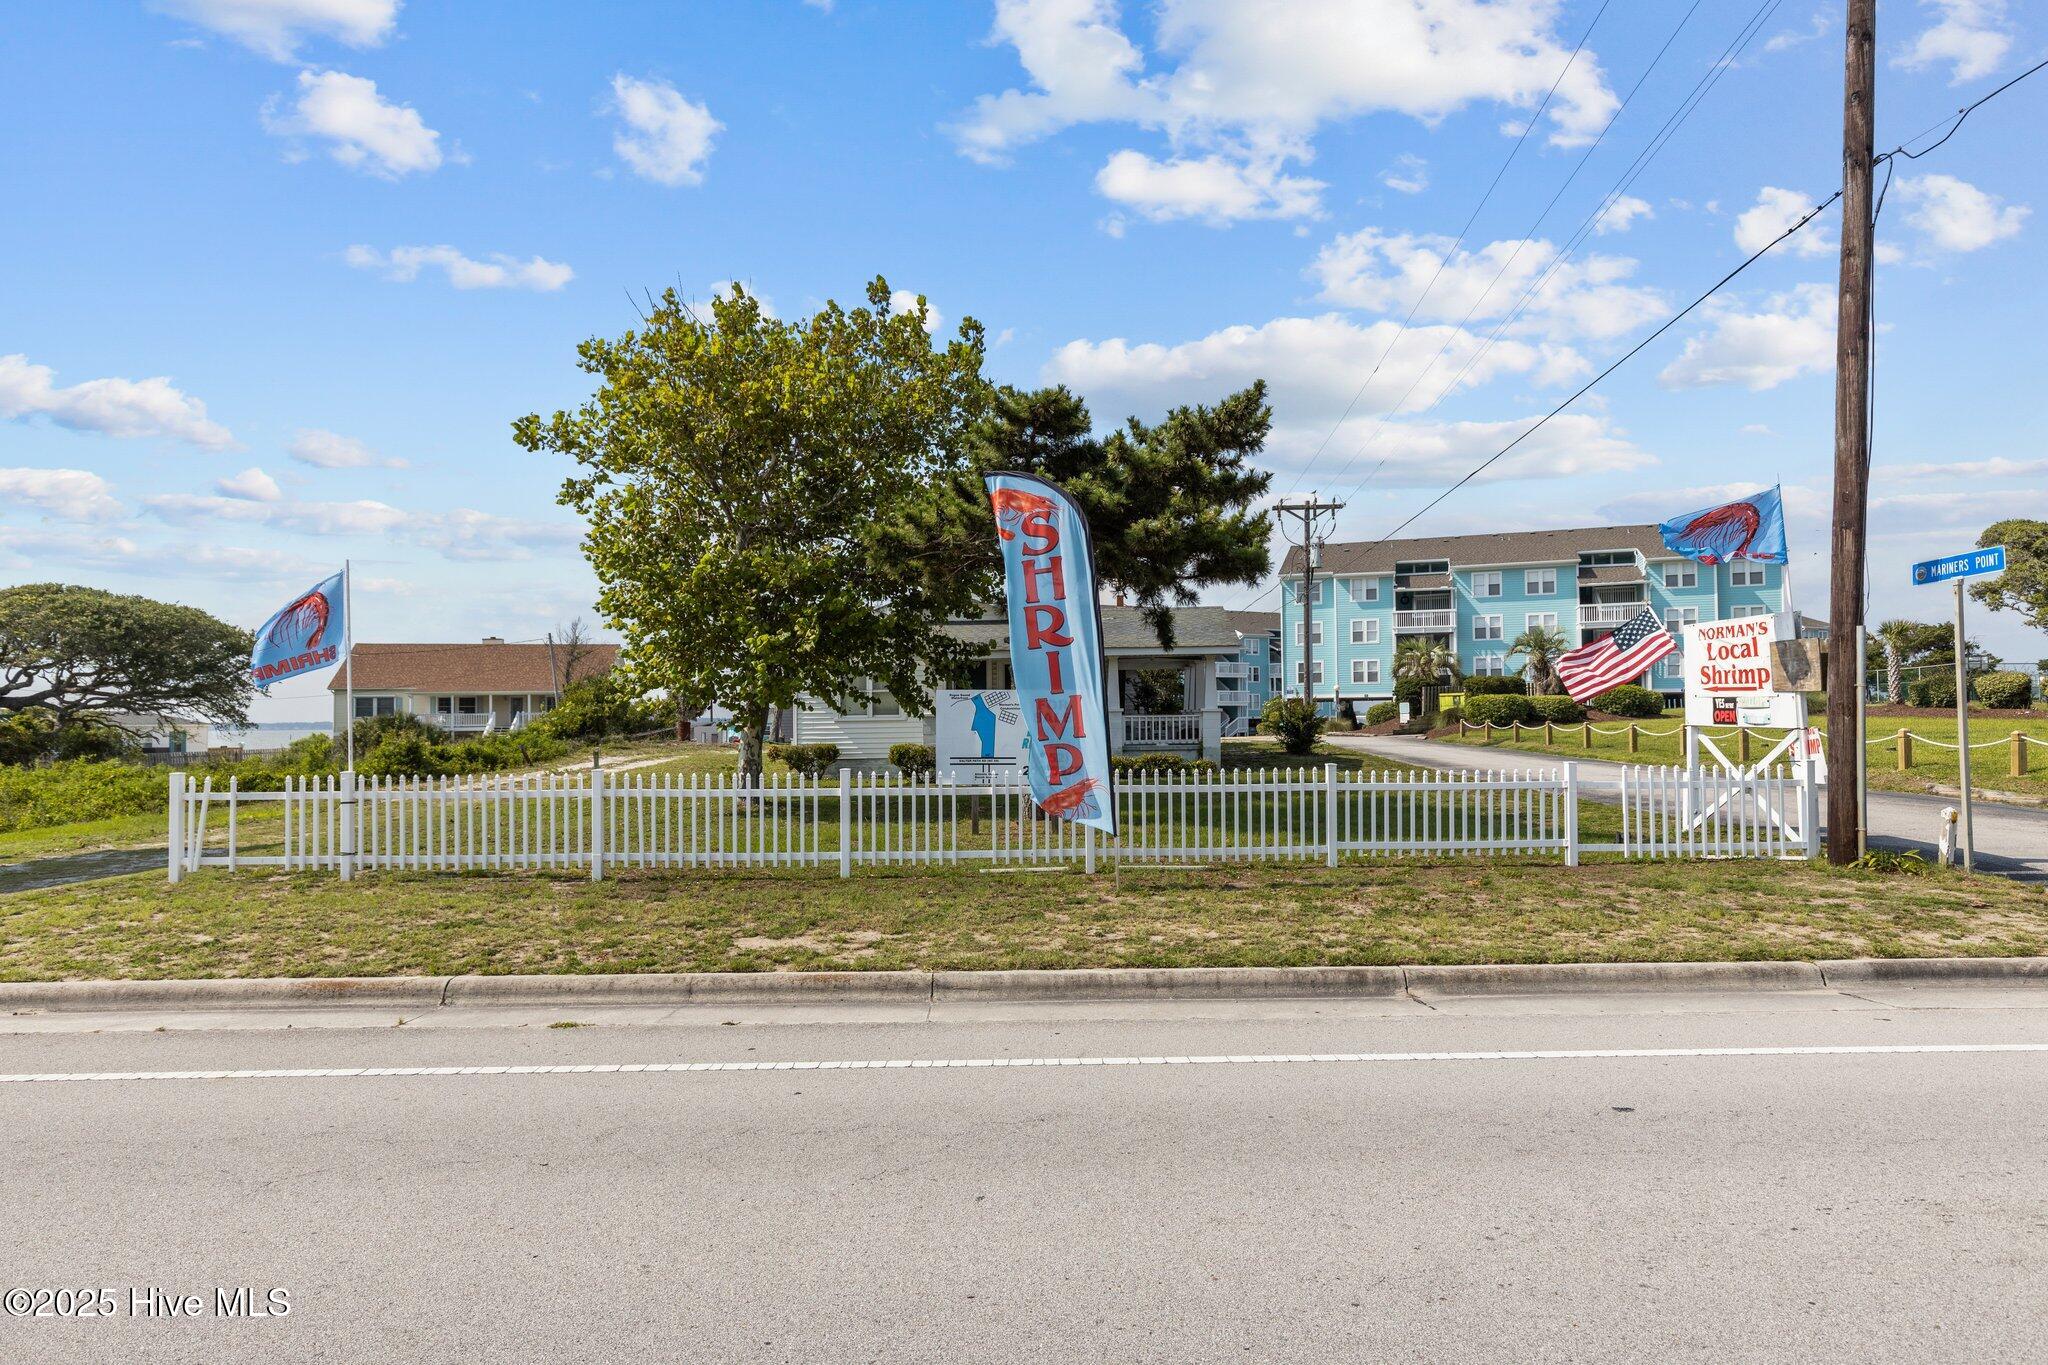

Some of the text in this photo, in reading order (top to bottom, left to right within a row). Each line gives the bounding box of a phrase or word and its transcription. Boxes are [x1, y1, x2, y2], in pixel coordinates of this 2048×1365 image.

[1931, 552, 1999, 577] MARINERS POINT
[1698, 621, 1768, 641] NORMAN'S
[1021, 511, 1086, 786] SHRIMP
[1707, 636, 1759, 661] Local
[1700, 664, 1771, 689] Shrimp
[1715, 698, 1725, 708] YES
[1714, 710, 1736, 723] OPEN
